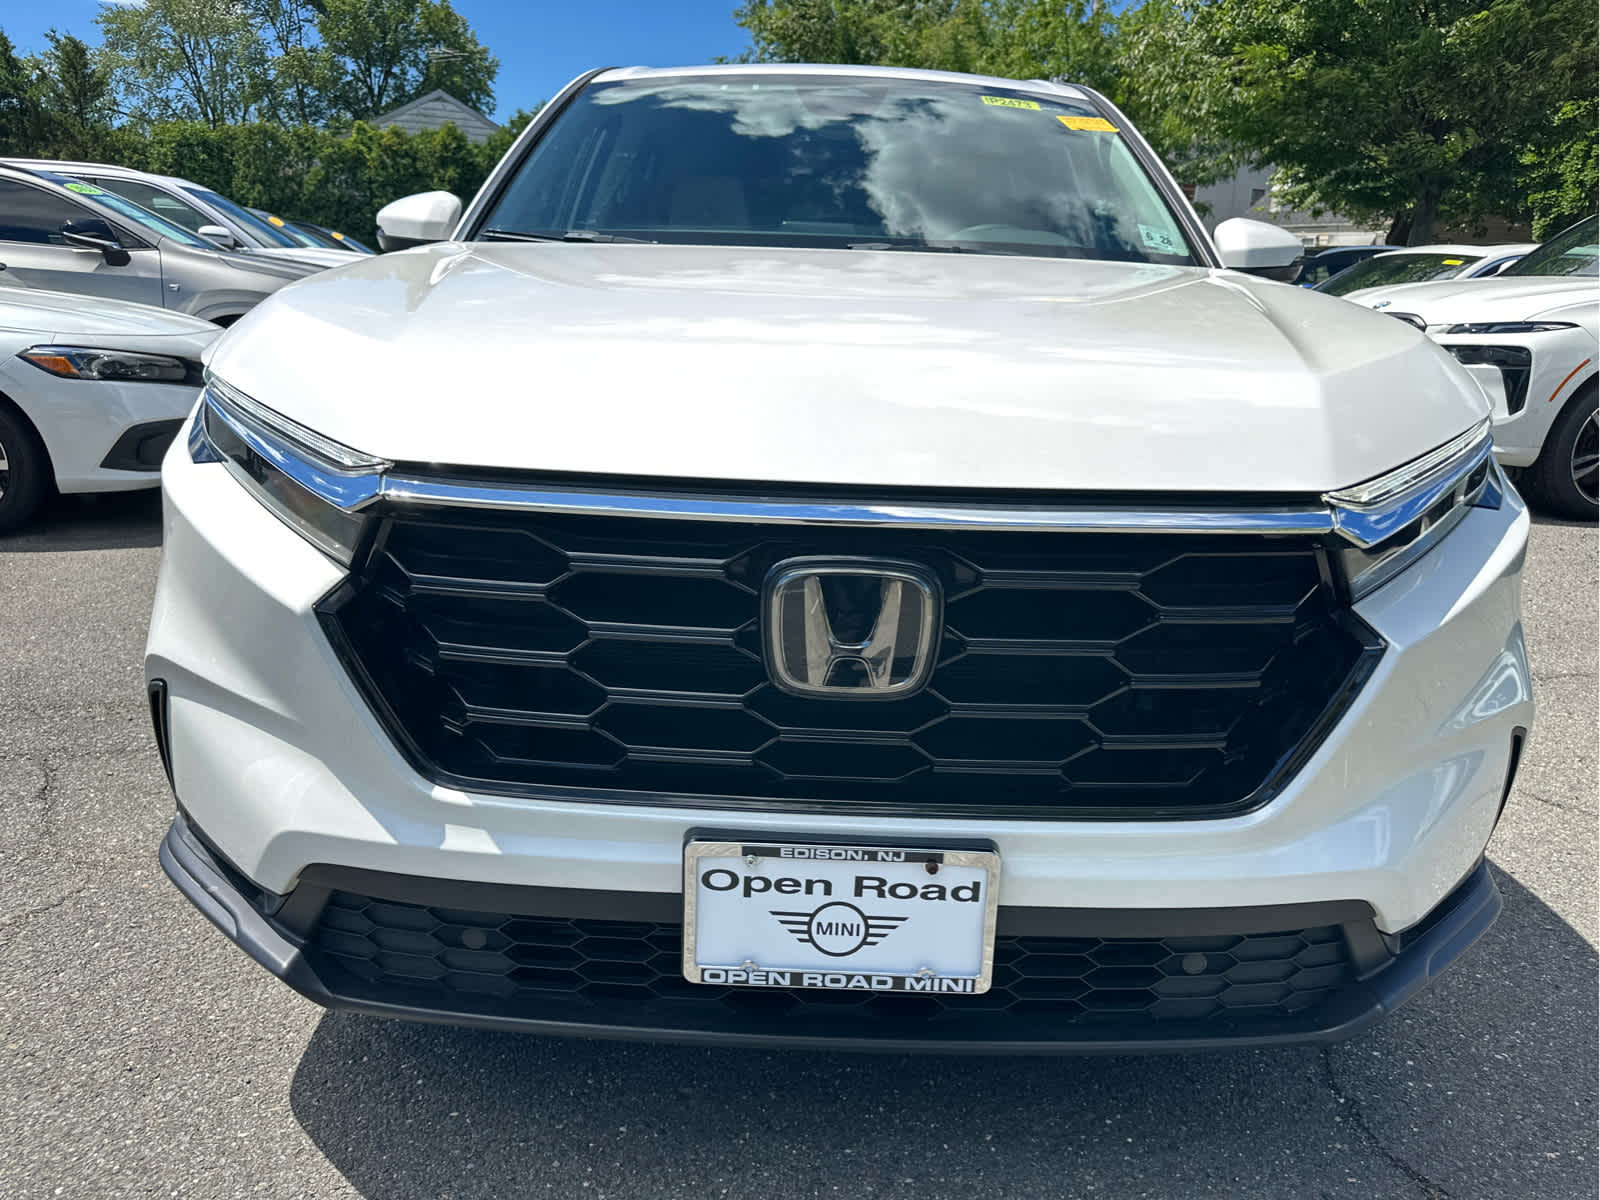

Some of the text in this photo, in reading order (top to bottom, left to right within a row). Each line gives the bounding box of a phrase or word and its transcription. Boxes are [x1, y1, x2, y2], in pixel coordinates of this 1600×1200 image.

[780, 847, 906, 862] EDISON, NJ
[701, 868, 981, 903] Open Road
[816, 921, 861, 937] MINI
[703, 969, 973, 993] OPEN ROAD MINI
